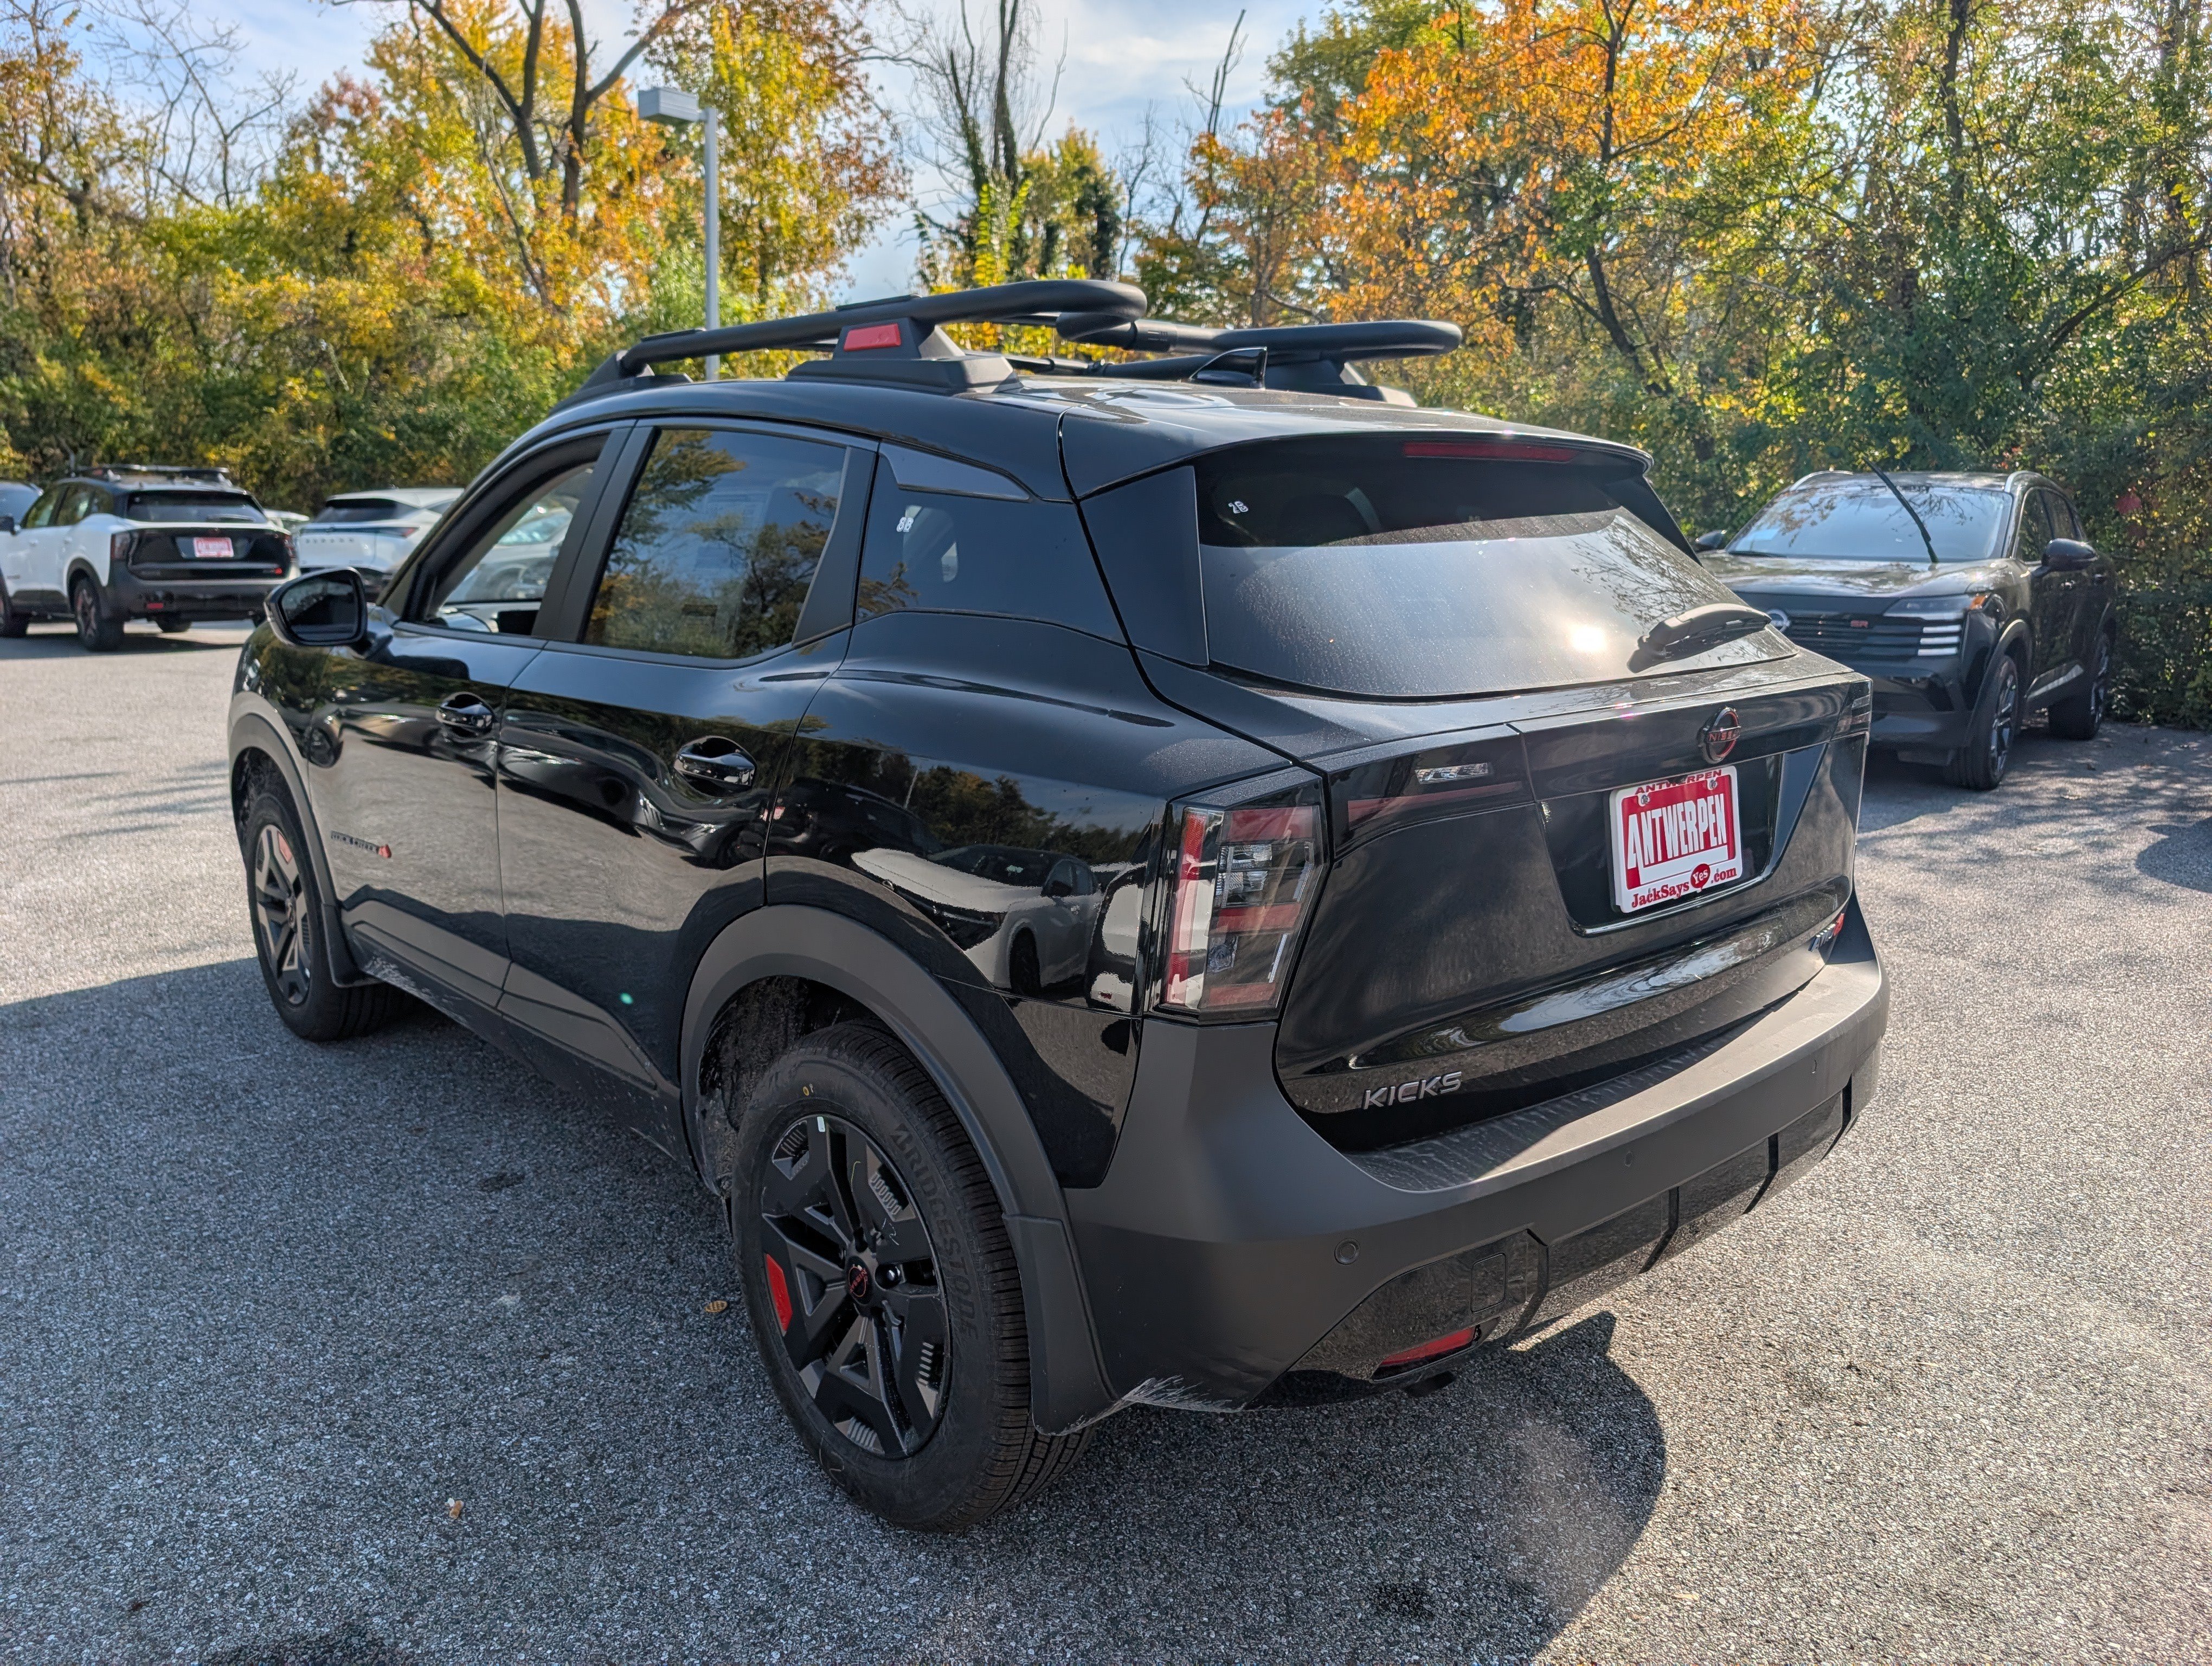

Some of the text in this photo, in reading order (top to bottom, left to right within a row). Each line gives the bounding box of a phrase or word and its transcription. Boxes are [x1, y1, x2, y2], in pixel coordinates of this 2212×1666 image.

[1627, 793, 1727, 870] ANTWERPEN
[1631, 880, 1690, 908] JackSays
[1692, 868, 1709, 885] Yes
[1363, 1071, 1462, 1110] KICKS
